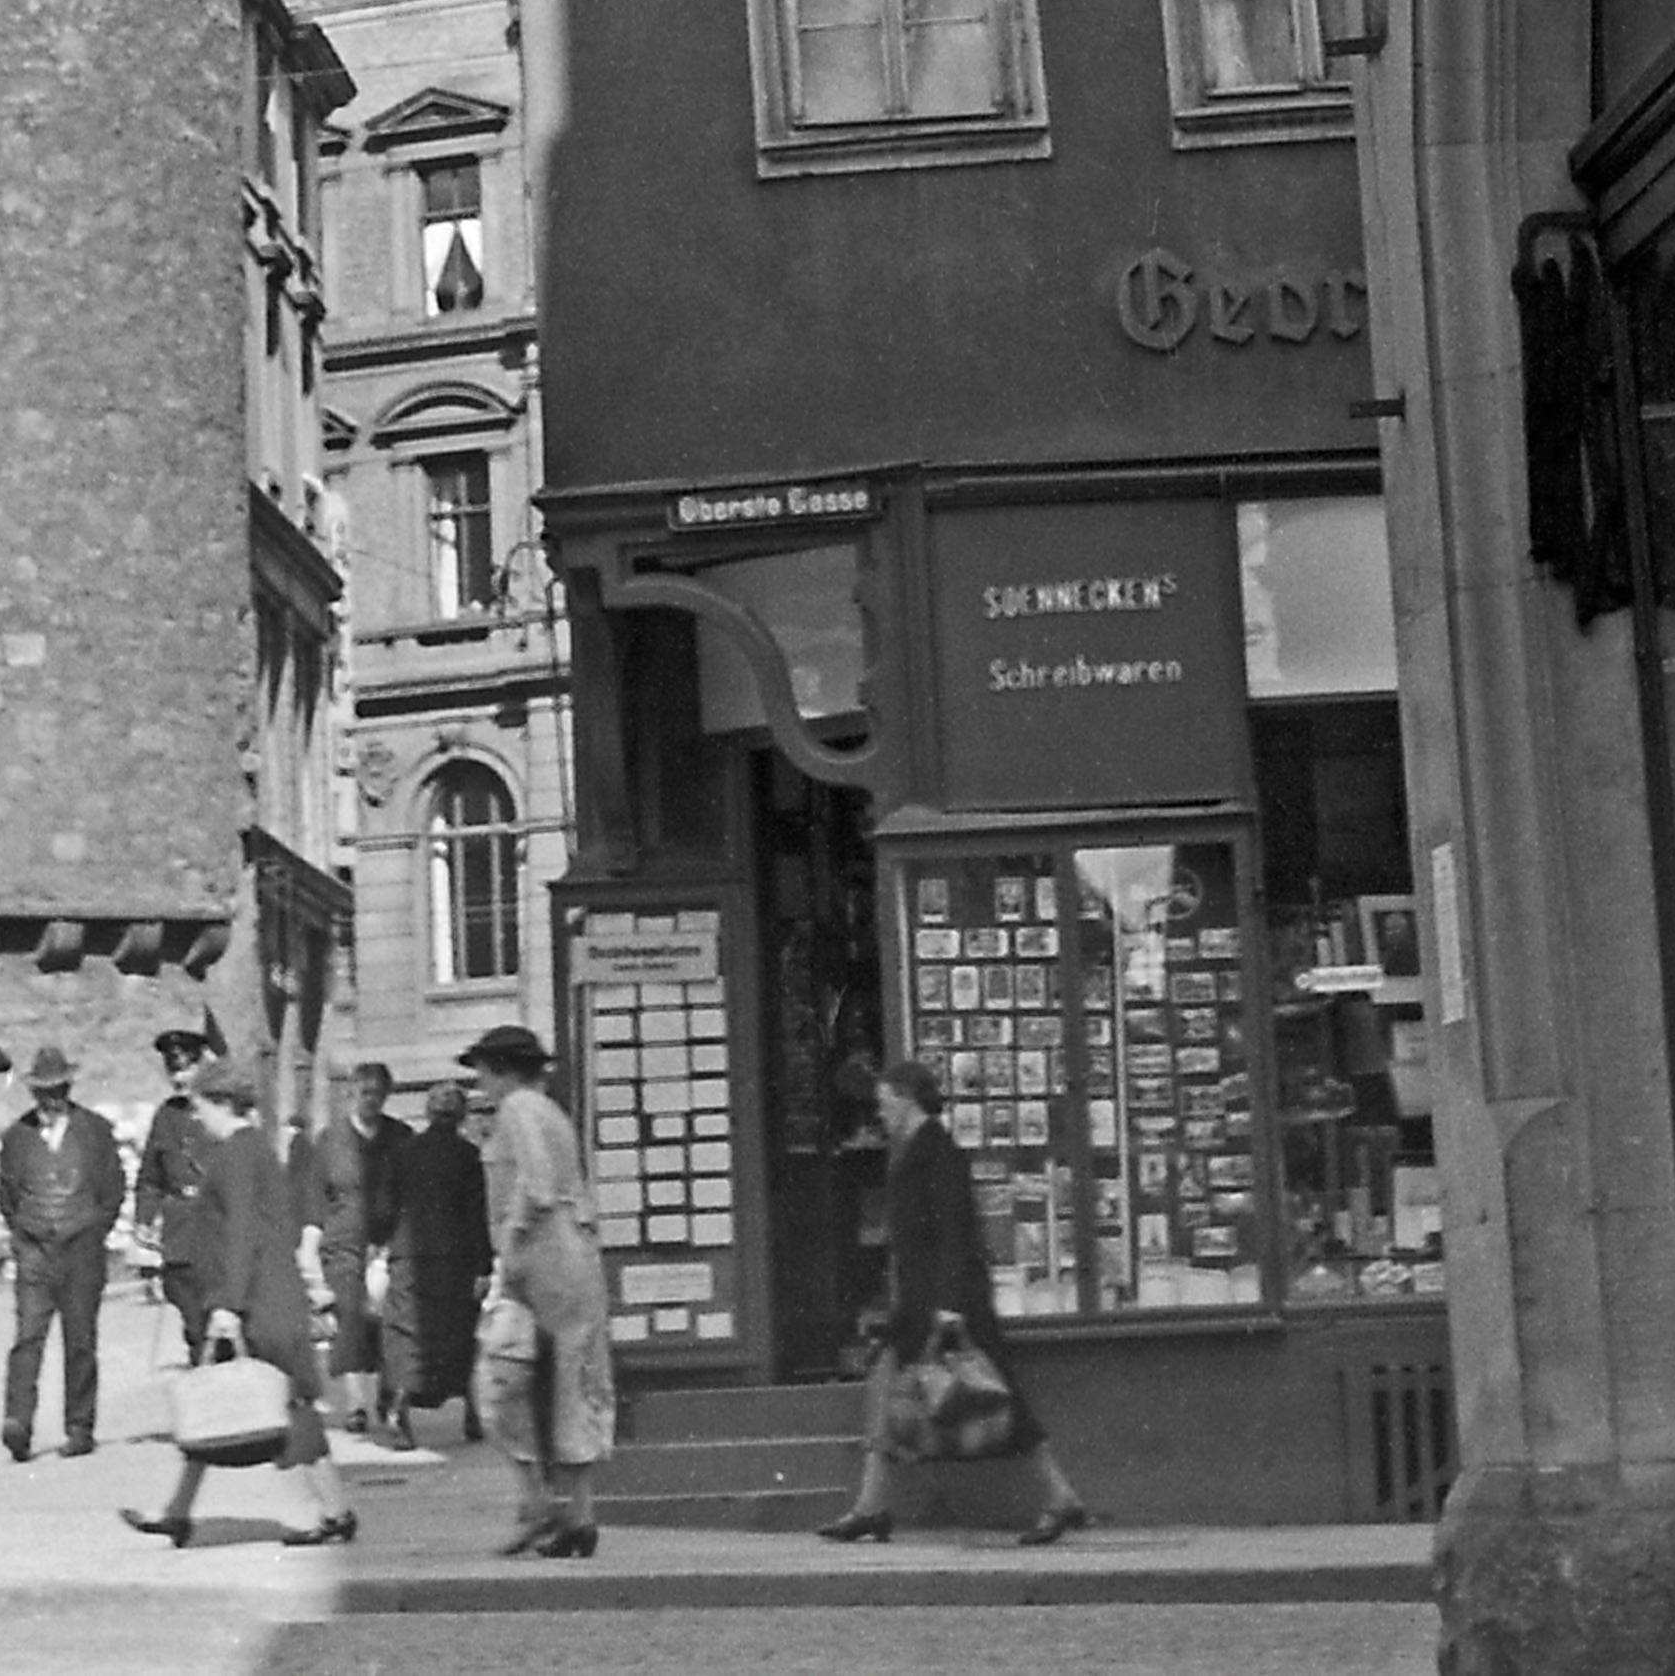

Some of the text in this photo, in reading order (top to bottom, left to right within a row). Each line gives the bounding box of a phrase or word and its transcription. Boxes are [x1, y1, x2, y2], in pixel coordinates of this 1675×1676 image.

[678, 486, 870, 524] Oberste Gasse
[988, 655, 1182, 692] Schreibwaren
